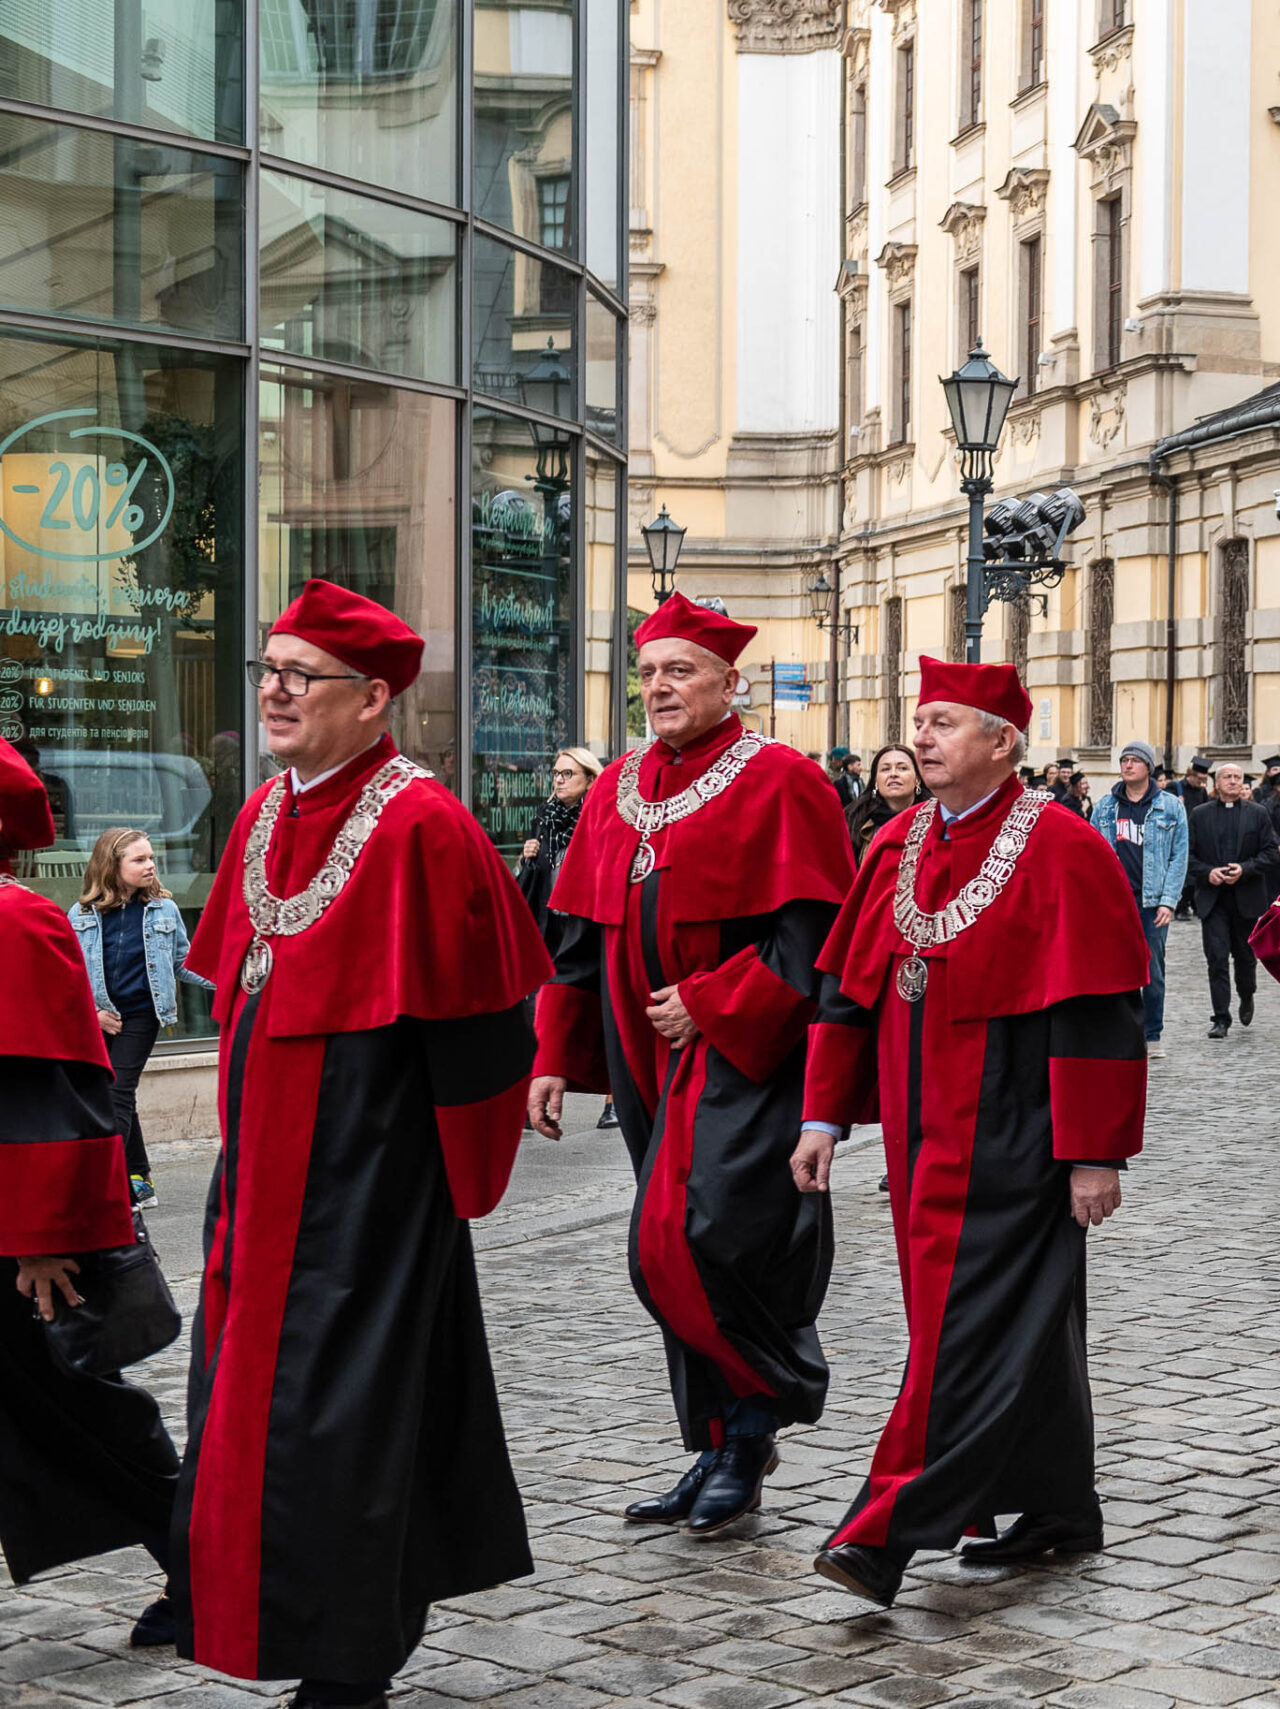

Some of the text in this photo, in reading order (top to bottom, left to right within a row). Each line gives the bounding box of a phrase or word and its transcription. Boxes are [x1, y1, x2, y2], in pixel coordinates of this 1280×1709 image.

[12, 457, 147, 532] -20%
[492, 587, 555, 632] restaurant
[6, 605, 161, 655] dużej rodziny!
[113, 671, 145, 683] SENIORS
[48, 698, 95, 710] STUDENTEN
[98, 699, 115, 710] UND
[118, 699, 157, 712] SENIOREN
[29, 727, 46, 738] для
[90, 728, 99, 737] та
[480, 771, 495, 805] де
